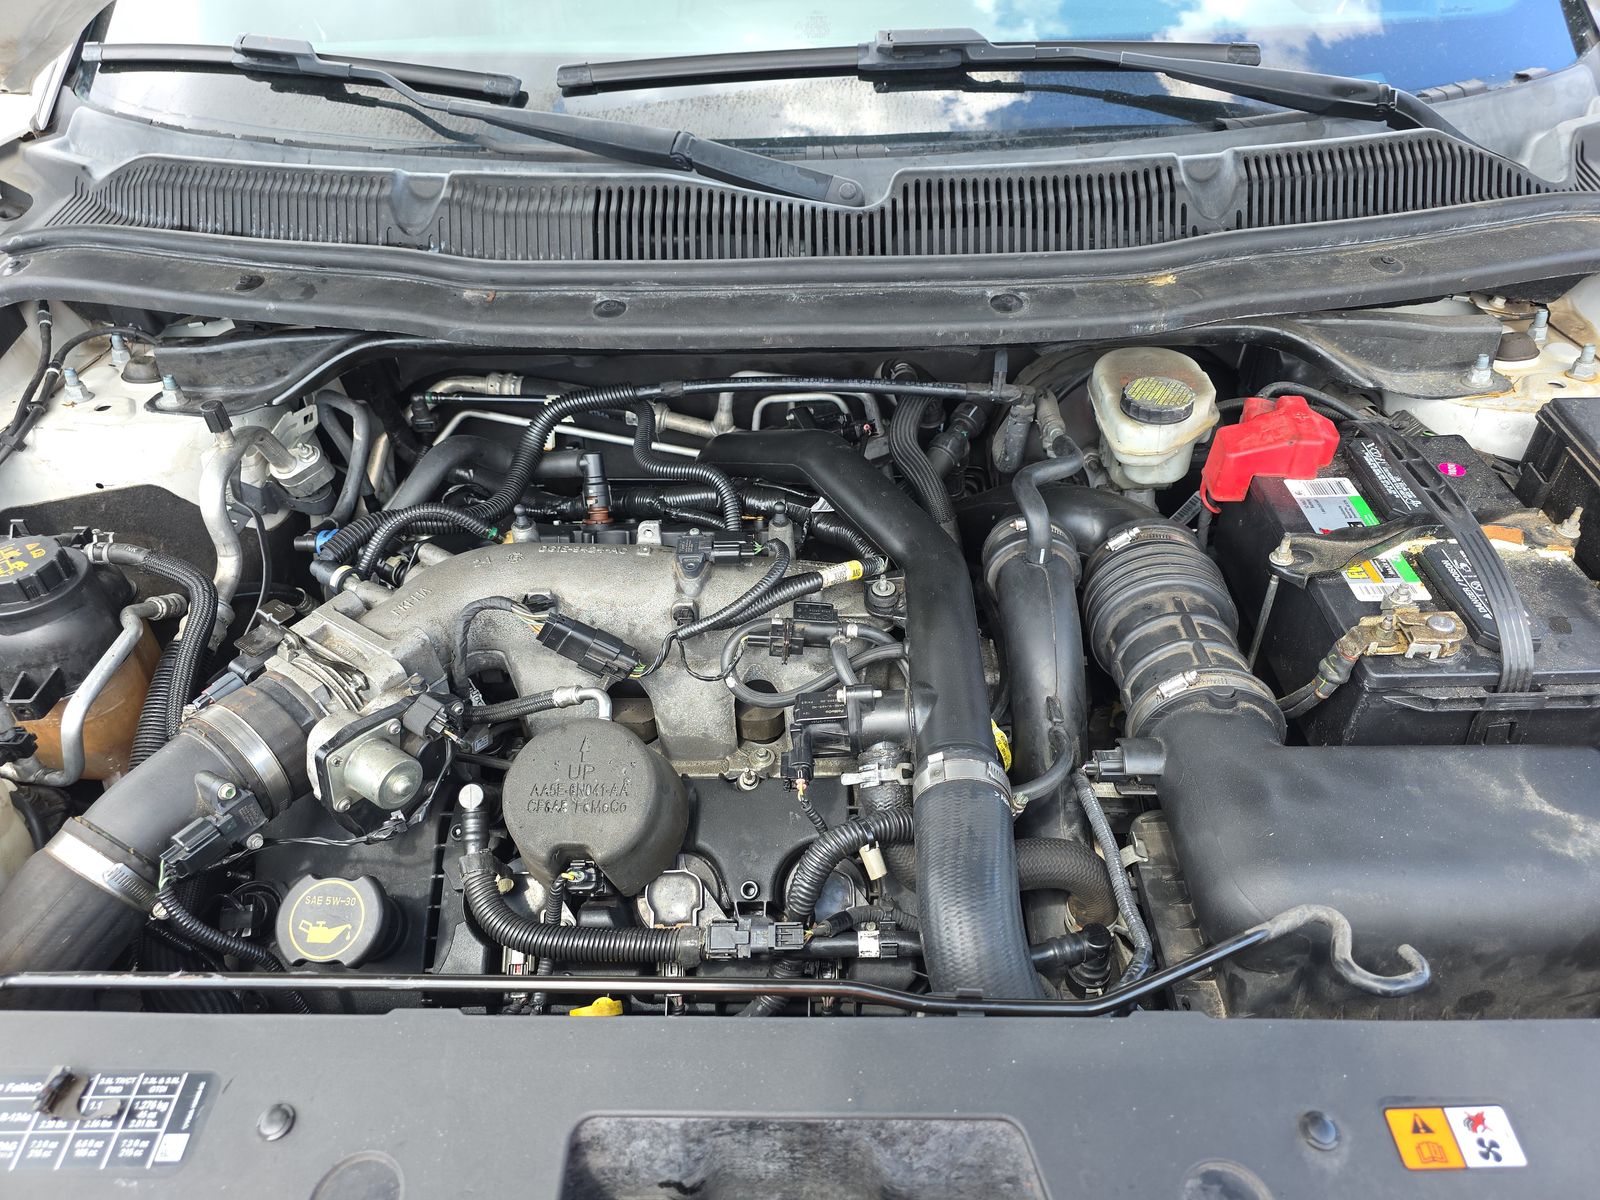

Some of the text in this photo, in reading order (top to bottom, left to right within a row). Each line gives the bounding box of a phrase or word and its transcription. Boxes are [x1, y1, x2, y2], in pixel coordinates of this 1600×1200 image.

[1441, 559, 1464, 582] POISON
[1462, 587, 1488, 613] DANGER
[568, 764, 595, 780] UP
[305, 895, 357, 906] SAE 5W-30
